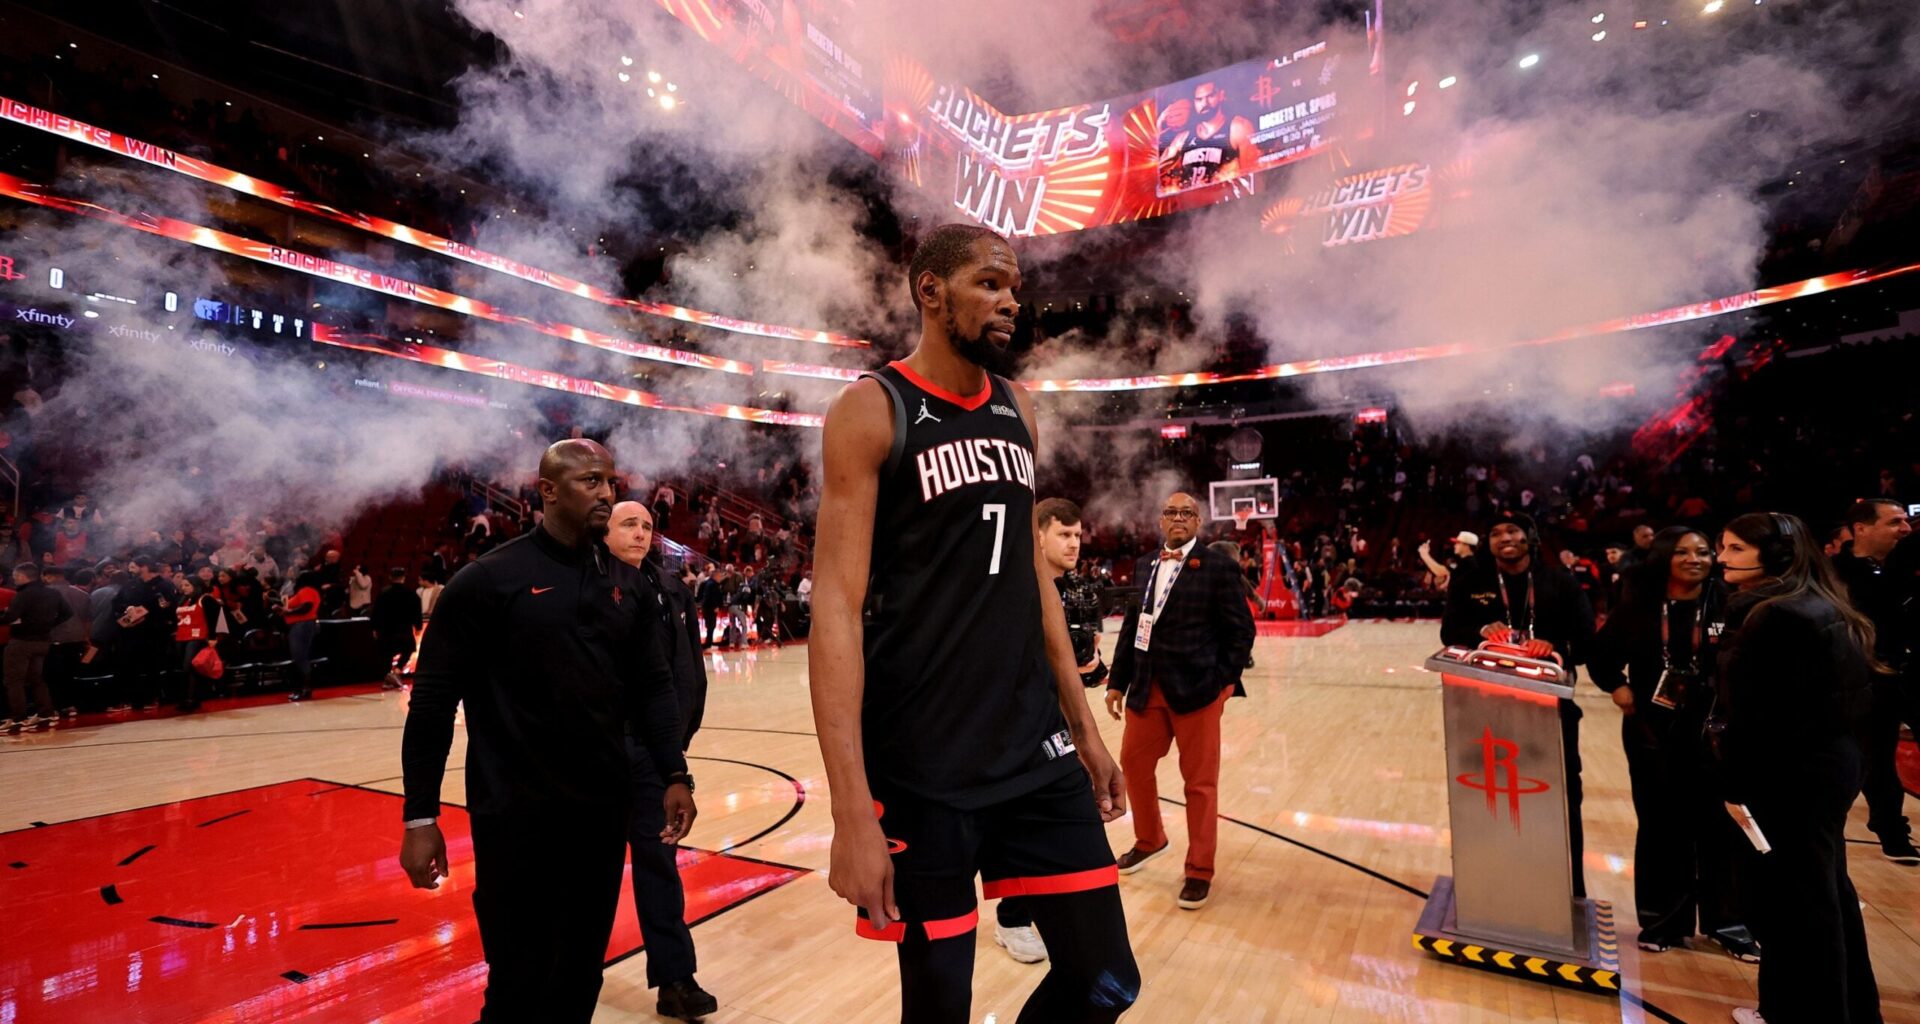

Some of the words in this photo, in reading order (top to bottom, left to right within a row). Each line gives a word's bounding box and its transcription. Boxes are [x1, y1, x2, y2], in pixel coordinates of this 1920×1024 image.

[125, 137, 177, 167] WIN
[954, 150, 1046, 238] WIN
[1322, 201, 1393, 248] WIN
[271, 246, 372, 286] ROCKETS
[381, 275, 416, 297] WIN
[16, 308, 76, 329] xfinity
[108, 324, 161, 344] xfinity
[190, 339, 236, 358] xfinity
[917, 437, 1036, 503] HOUSTON
[982, 503, 1006, 575] 7
